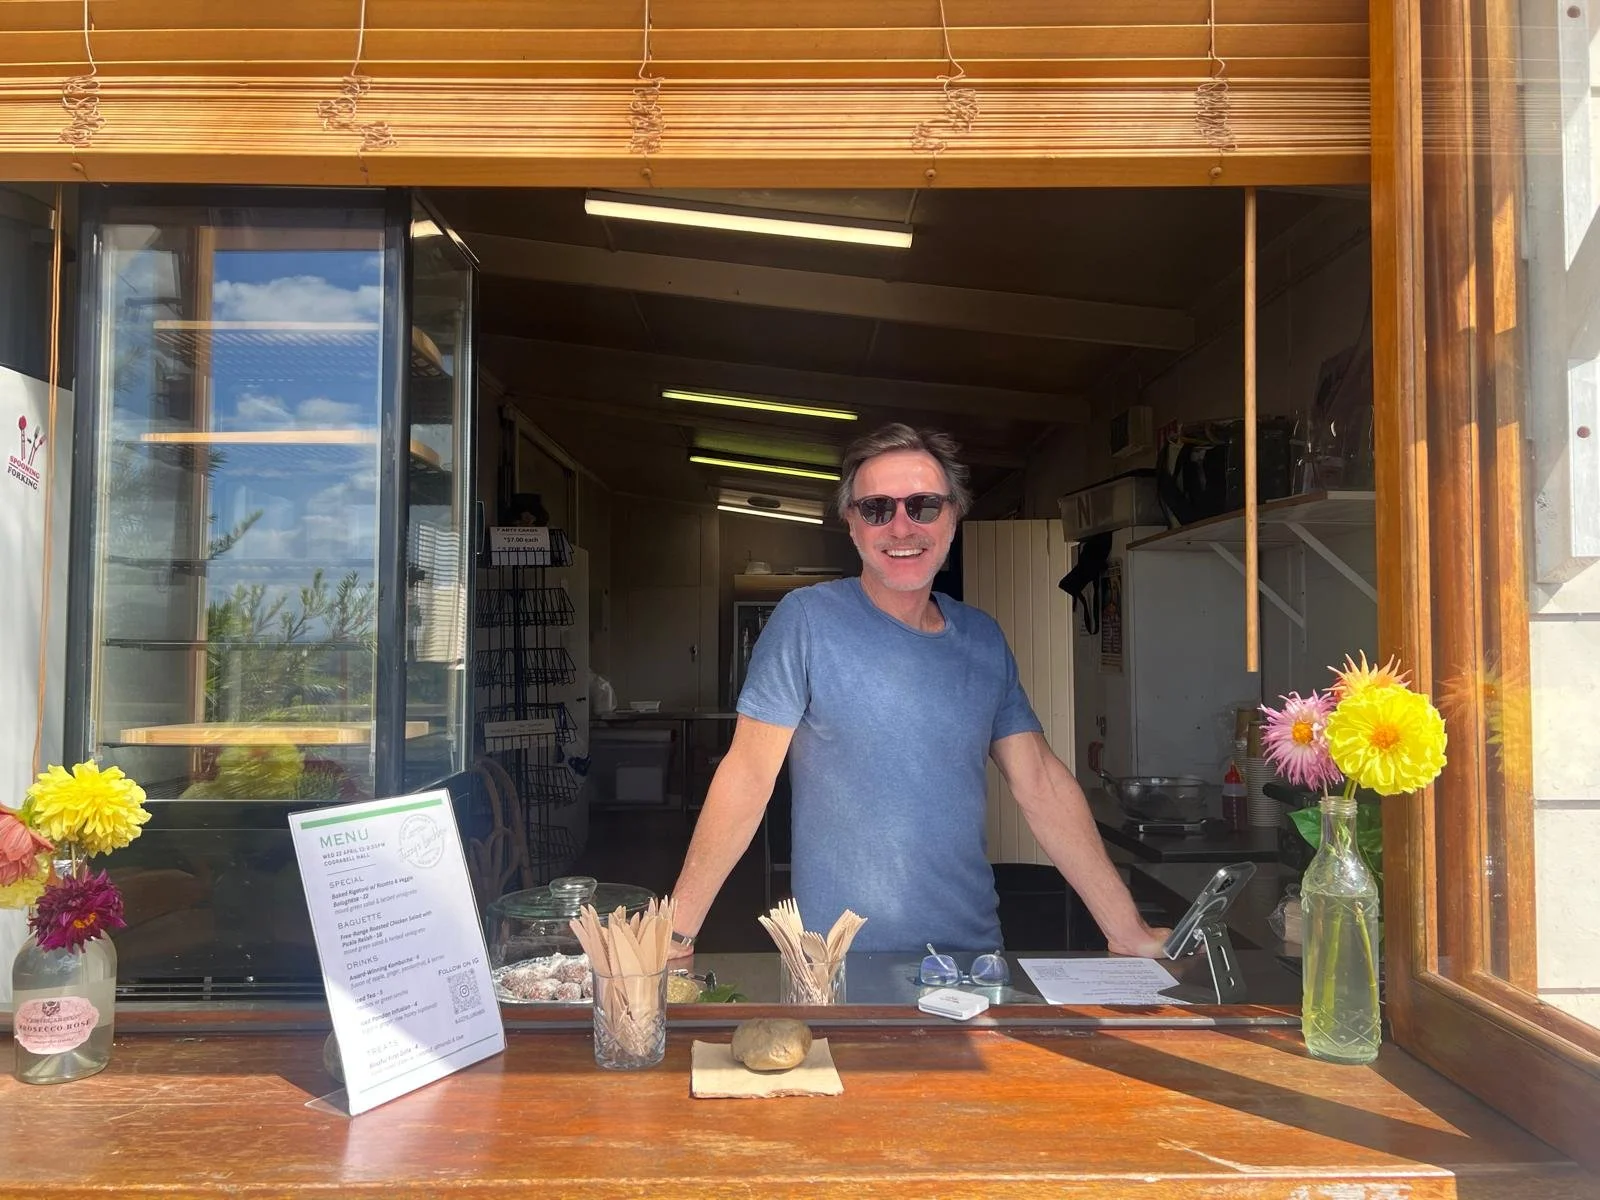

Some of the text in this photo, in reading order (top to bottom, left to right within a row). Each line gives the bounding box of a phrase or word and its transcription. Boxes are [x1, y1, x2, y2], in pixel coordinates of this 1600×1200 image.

[9, 455, 40, 479] SPOONING
[8, 466, 38, 490] FORKING
[320, 829, 370, 849] MENU
[329, 875, 364, 889] SPECIAL
[332, 891, 348, 900] Baked
[333, 897, 360, 908] Bolognese
[338, 913, 382, 930] BAGUETTE
[340, 929, 369, 941] Free-Range
[370, 923, 389, 932] Roasted
[390, 917, 408, 926] Chicken
[342, 939, 357, 948] Pickle
[358, 935, 373, 943] Relish
[346, 955, 379, 971] DRINKS
[438, 964, 462, 976] FOLLOW
[349, 965, 388, 982] Award-Winning
